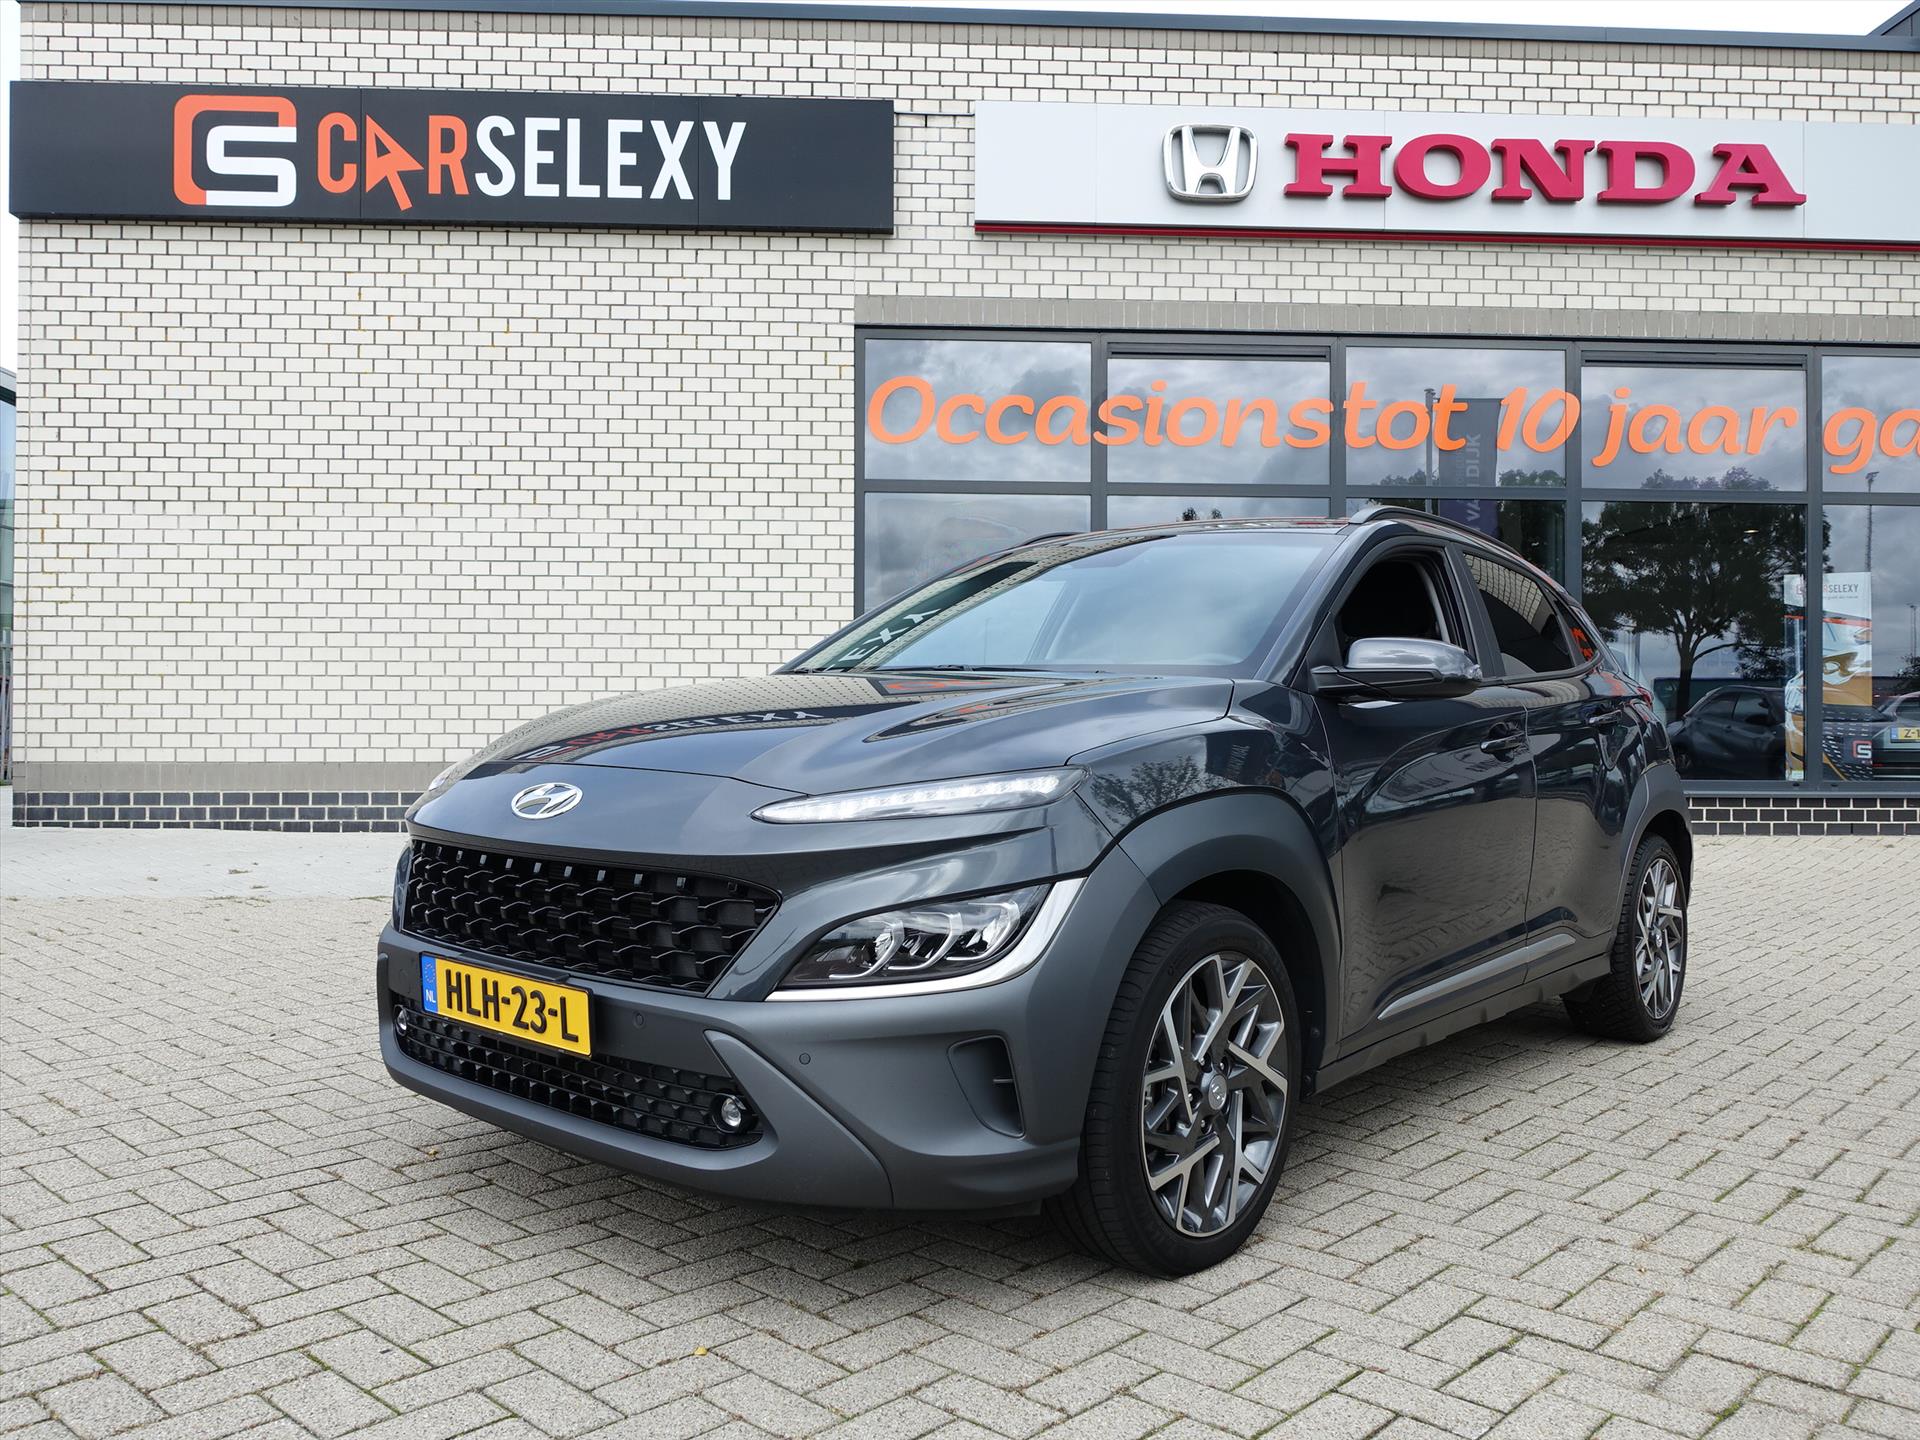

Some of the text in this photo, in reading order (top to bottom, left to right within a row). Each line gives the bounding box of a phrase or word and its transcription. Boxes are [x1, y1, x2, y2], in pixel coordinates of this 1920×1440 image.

[317, 111, 747, 210] CARSELEXY
[1284, 132, 1807, 207] HONDA
[867, 375, 1334, 449] Occasions
[1343, 381, 1468, 451] tot
[1496, 386, 1581, 453] 10
[1591, 387, 1799, 467] jaar
[1823, 583, 1859, 593] RSELEXY
[425, 969, 579, 1043] NL HLH-23-L
